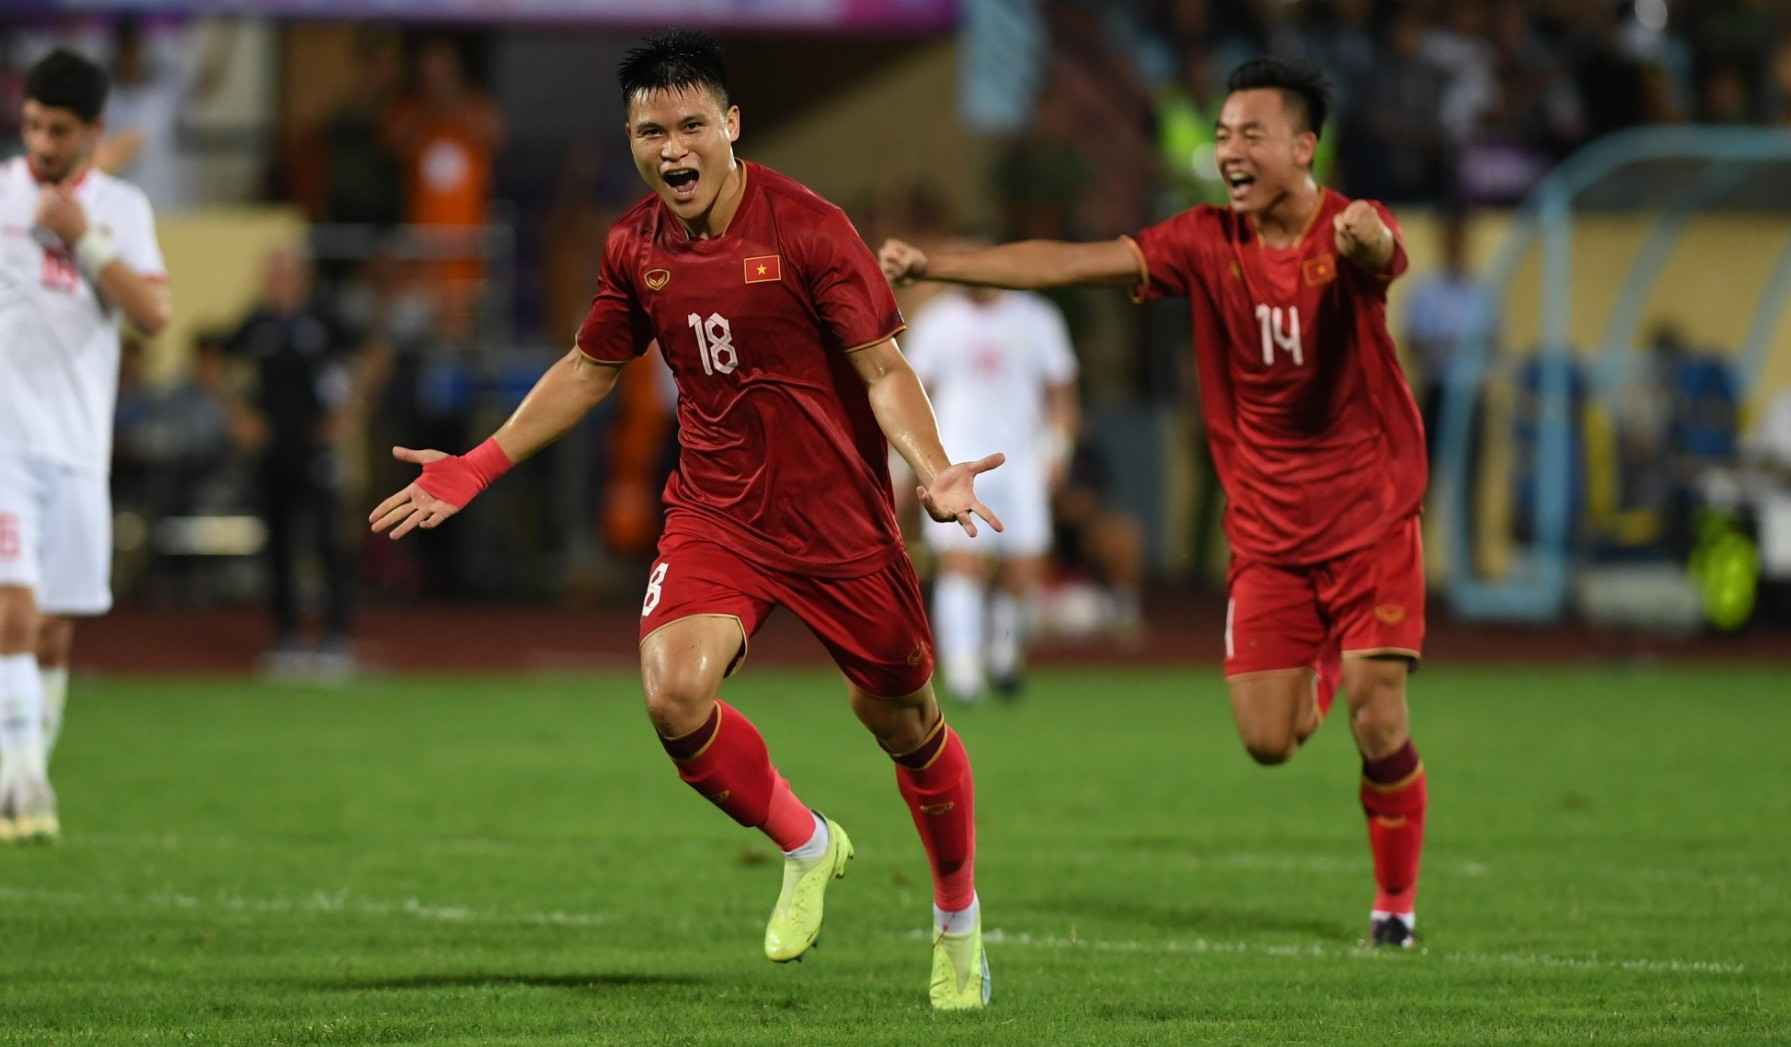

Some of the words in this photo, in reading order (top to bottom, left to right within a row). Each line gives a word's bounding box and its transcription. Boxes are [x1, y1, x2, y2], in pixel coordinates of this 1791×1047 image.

[687, 312, 739, 376] 18
[1255, 303, 1304, 366] 14
[641, 562, 669, 617] 8
